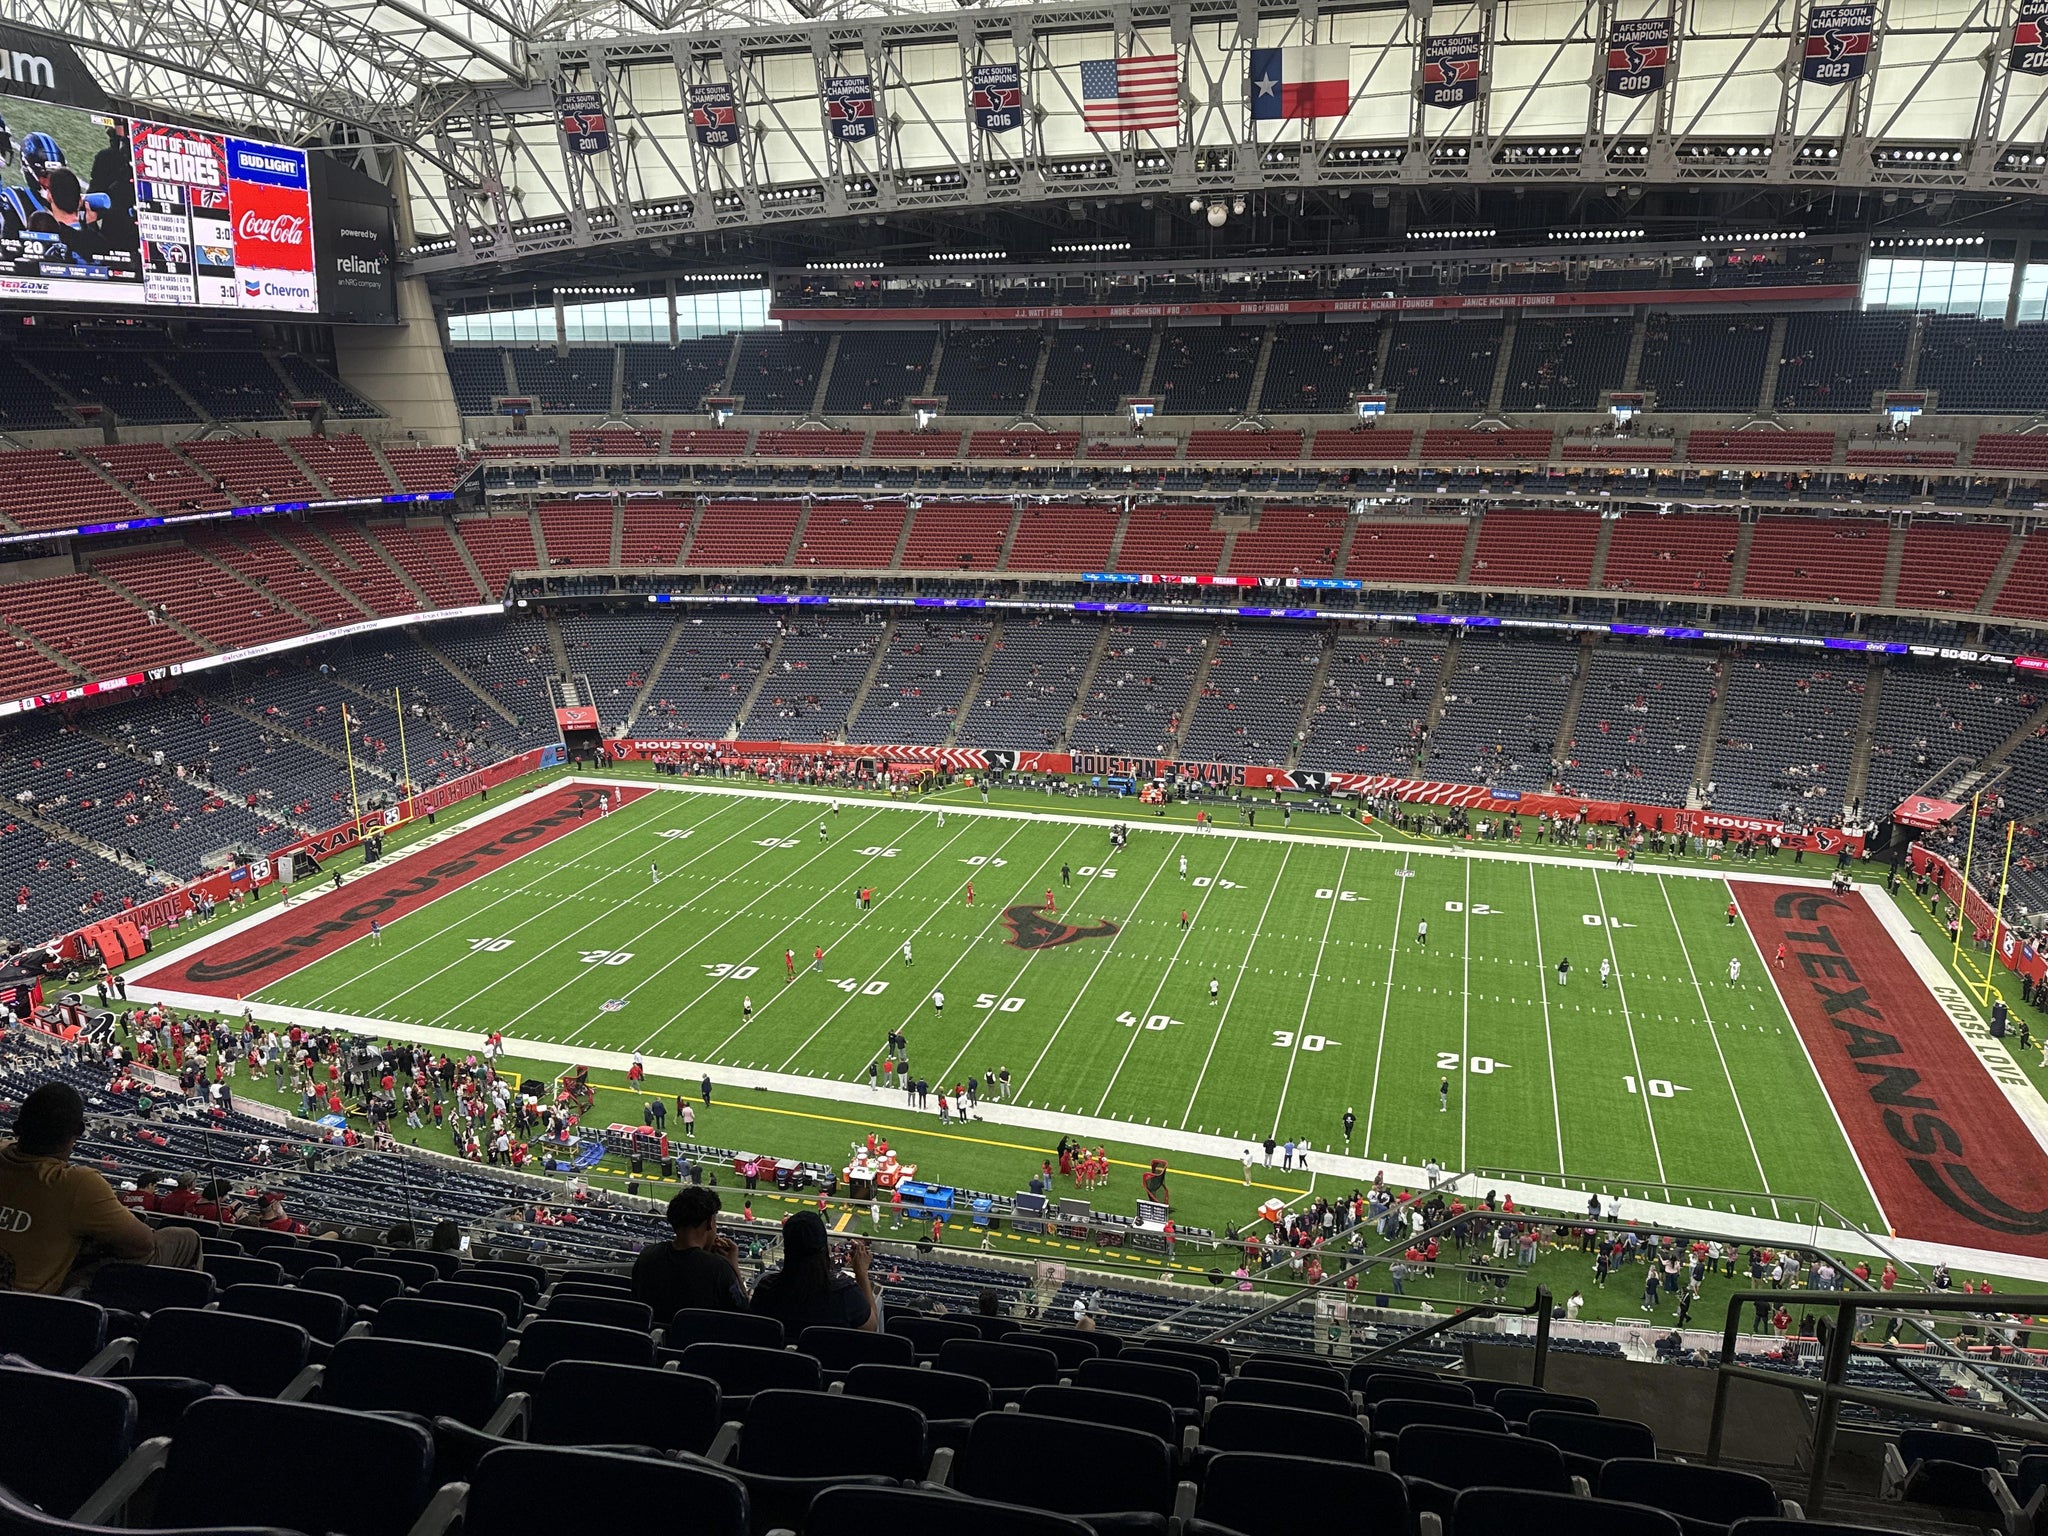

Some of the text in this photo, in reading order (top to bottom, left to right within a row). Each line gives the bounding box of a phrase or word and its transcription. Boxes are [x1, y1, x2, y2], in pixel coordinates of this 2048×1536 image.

[1820, 8, 1867, 18] AFC SOUTH
[2022, 5, 2048, 15] CHA
[1619, 22, 1664, 32] AFC SOUTH
[1812, 16, 1872, 29] CHAMPIONS
[1432, 37, 1473, 47] AFC SOUTH
[1612, 30, 1668, 43] CHAMPIONS
[1426, 44, 1478, 57] CHAMPIONS
[978, 66, 1012, 76] AFC SOUTH
[1816, 63, 1849, 78] 2023
[844, 78, 864, 86] SOUTH
[974, 74, 1017, 85] CHAMPIONS
[1618, 75, 1651, 90] 2019
[828, 85, 870, 95] CHAMPIONS
[1434, 88, 1464, 102] 2018
[692, 93, 730, 103] CHAMPIONS
[562, 102, 600, 111] CHAMPIONS
[986, 114, 1011, 127] 2016
[842, 123, 866, 136] 2015
[579, 137, 597, 149] 2011
[706, 130, 729, 143] 2012
[147, 133, 213, 158] OUT OF TOWN
[143, 148, 220, 187] SCORES
[240, 154, 297, 175] BUD LIGHT
[160, 202, 171, 213] 13
[238, 210, 305, 245] Coca-Cola
[340, 228, 378, 241] powered by
[24, 241, 43, 254] 20
[337, 254, 382, 275] reliant
[265, 283, 310, 298] Chevron
[345, 279, 358, 288] NRG
[358, 281, 382, 291] company
[1334, 299, 1434, 310] ROBERT C. MCNAIR FOUNDER
[1463, 296, 1555, 306] JANICE MCNAIR FOUNDER
[1028, 309, 1044, 317] WATT
[1050, 309, 1063, 317] #99
[1110, 306, 1180, 316] ANDRE JOHNSON #80
[1240, 303, 1289, 313] RING HONOR
[635, 741, 717, 750] HOUSTON
[1071, 755, 1246, 787] HOUSTON TEXANS
[432, 793, 445, 810] UP
[385, 808, 400, 824] 25
[1910, 819, 1932, 829] Chevron
[416, 836, 438, 848] OF
[442, 825, 468, 838] US
[661, 828, 695, 842] 10
[758, 837, 800, 848] 20
[860, 846, 902, 857] 30
[966, 855, 1008, 867] 40
[253, 863, 269, 879] 25
[1076, 866, 1119, 878] 50
[293, 809, 590, 948] HOUSTON
[1192, 876, 1235, 889] 40
[1314, 888, 1358, 902] 30
[140, 895, 184, 927] MADE
[1445, 901, 1490, 915] 20
[1582, 914, 1622, 929] 10
[469, 937, 516, 952] 10
[580, 949, 635, 966] 20
[705, 963, 760, 980] 30
[837, 977, 890, 996] 40
[972, 993, 1026, 1012] 50
[1115, 1011, 1171, 1031] 40
[1271, 1030, 1326, 1052] 30
[1784, 925, 1963, 1157] TEXANS
[1933, 985, 1993, 1041] CHOOSE
[1975, 1045, 2029, 1087] LOVE
[1436, 1051, 1494, 1074] 20
[1621, 1075, 1675, 1098] 10
[880, 1174, 889, 1184] G
[0, 1205, 32, 1233] ED
